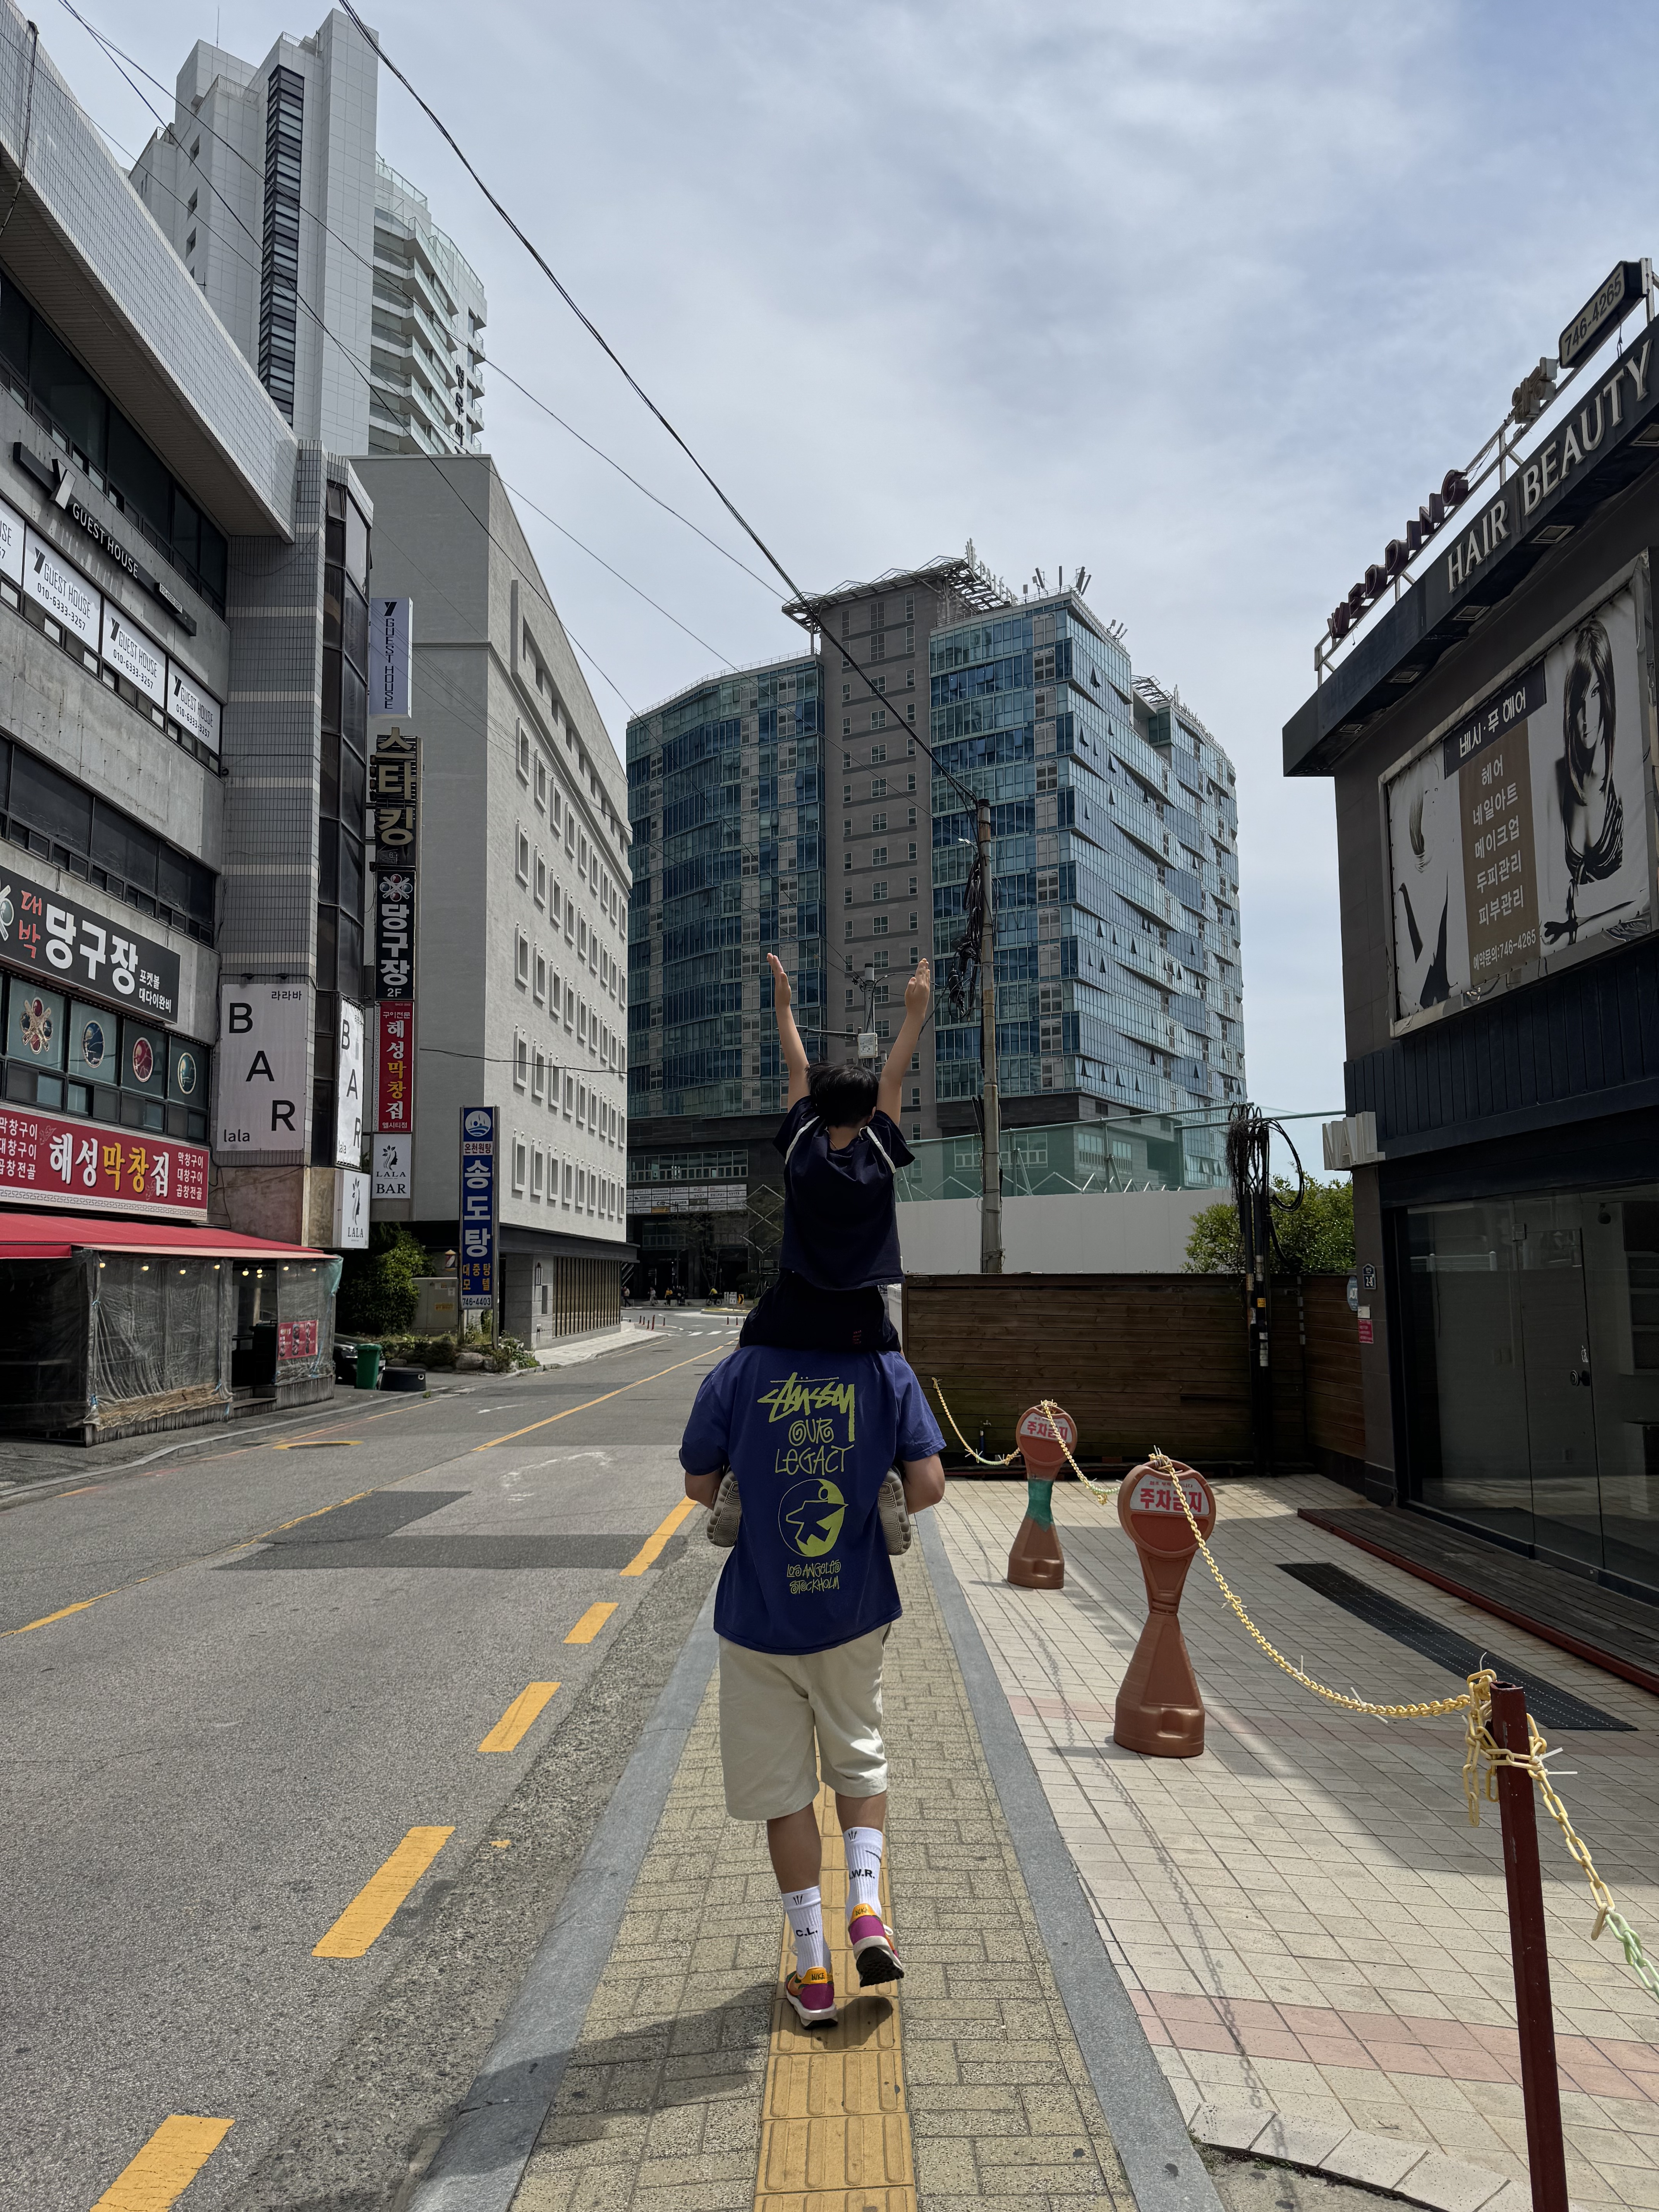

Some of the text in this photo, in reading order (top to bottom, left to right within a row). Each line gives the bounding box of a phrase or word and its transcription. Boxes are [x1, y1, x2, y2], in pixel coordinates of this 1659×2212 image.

[1564, 272, 1622, 356] 746-4265
[1447, 338, 1653, 593] HAIR BEAUTY
[72, 503, 105, 544] GUEST
[107, 536, 138, 578] HOUSE
[38, 583, 86, 630] 010-6333-3257
[44, 563, 67, 596] GUEST
[69, 585, 91, 618] HOUSE
[113, 649, 153, 689] 010-6333-3257
[119, 631, 137, 660] GUEST
[139, 648, 157, 678] HOUSE
[385, 618, 394, 709] GUEST HOUSE
[177, 704, 210, 738] 010-6333-3257
[181, 687, 196, 713] GUEST
[198, 701, 213, 727] HOUSE
[1503, 687, 1526, 723] 헤어
[376, 727, 416, 846] 스타킹
[1481, 754, 1503, 786] 헤어
[1473, 782, 1518, 826] 네일아트
[1474, 816, 1520, 859] 메이크업
[1476, 851, 1522, 893] 두피관리
[19, 890, 42, 958] 대박
[1479, 885, 1524, 926] 피부관리
[46, 903, 138, 994] 당구장
[380, 903, 410, 986] 당구장
[139, 969, 160, 990] 포켓볼
[271, 990, 302, 1001] 라라바
[387, 988, 402, 997] 2F
[229, 1003, 296, 1131] BAR
[342, 1019, 361, 1149] BAR
[386, 1020, 407, 1120] 해성막창집
[223, 1128, 250, 1142] lala
[338, 1140, 347, 1154] lala
[465, 1143, 491, 1154] 온천원탕
[1322, 1111, 1385, 1171] NAIL
[50, 1133, 169, 1197] 해성막창집
[177, 1168, 203, 1184] 대창구이
[178, 1152, 203, 1168] 막창구이
[176, 1184, 202, 1200] 곱창전골
[376, 1183, 406, 1194] BAR
[464, 1160, 491, 1257] 송도탕
[348, 1227, 363, 1238] LALA
[462, 1263, 491, 1276] 대중탕
[462, 1278, 490, 1291] 모텔
[462, 1297, 491, 1306] 746-4403
[788, 1418, 833, 1446] OUR
[1140, 1488, 1202, 1512] 주차금지
[787, 1562, 802, 1578] LOS
[790, 1578, 839, 1594] STOCKHOLM
[796, 1927, 818, 1937] C.L.
[811, 1973, 825, 1981] NIKE
